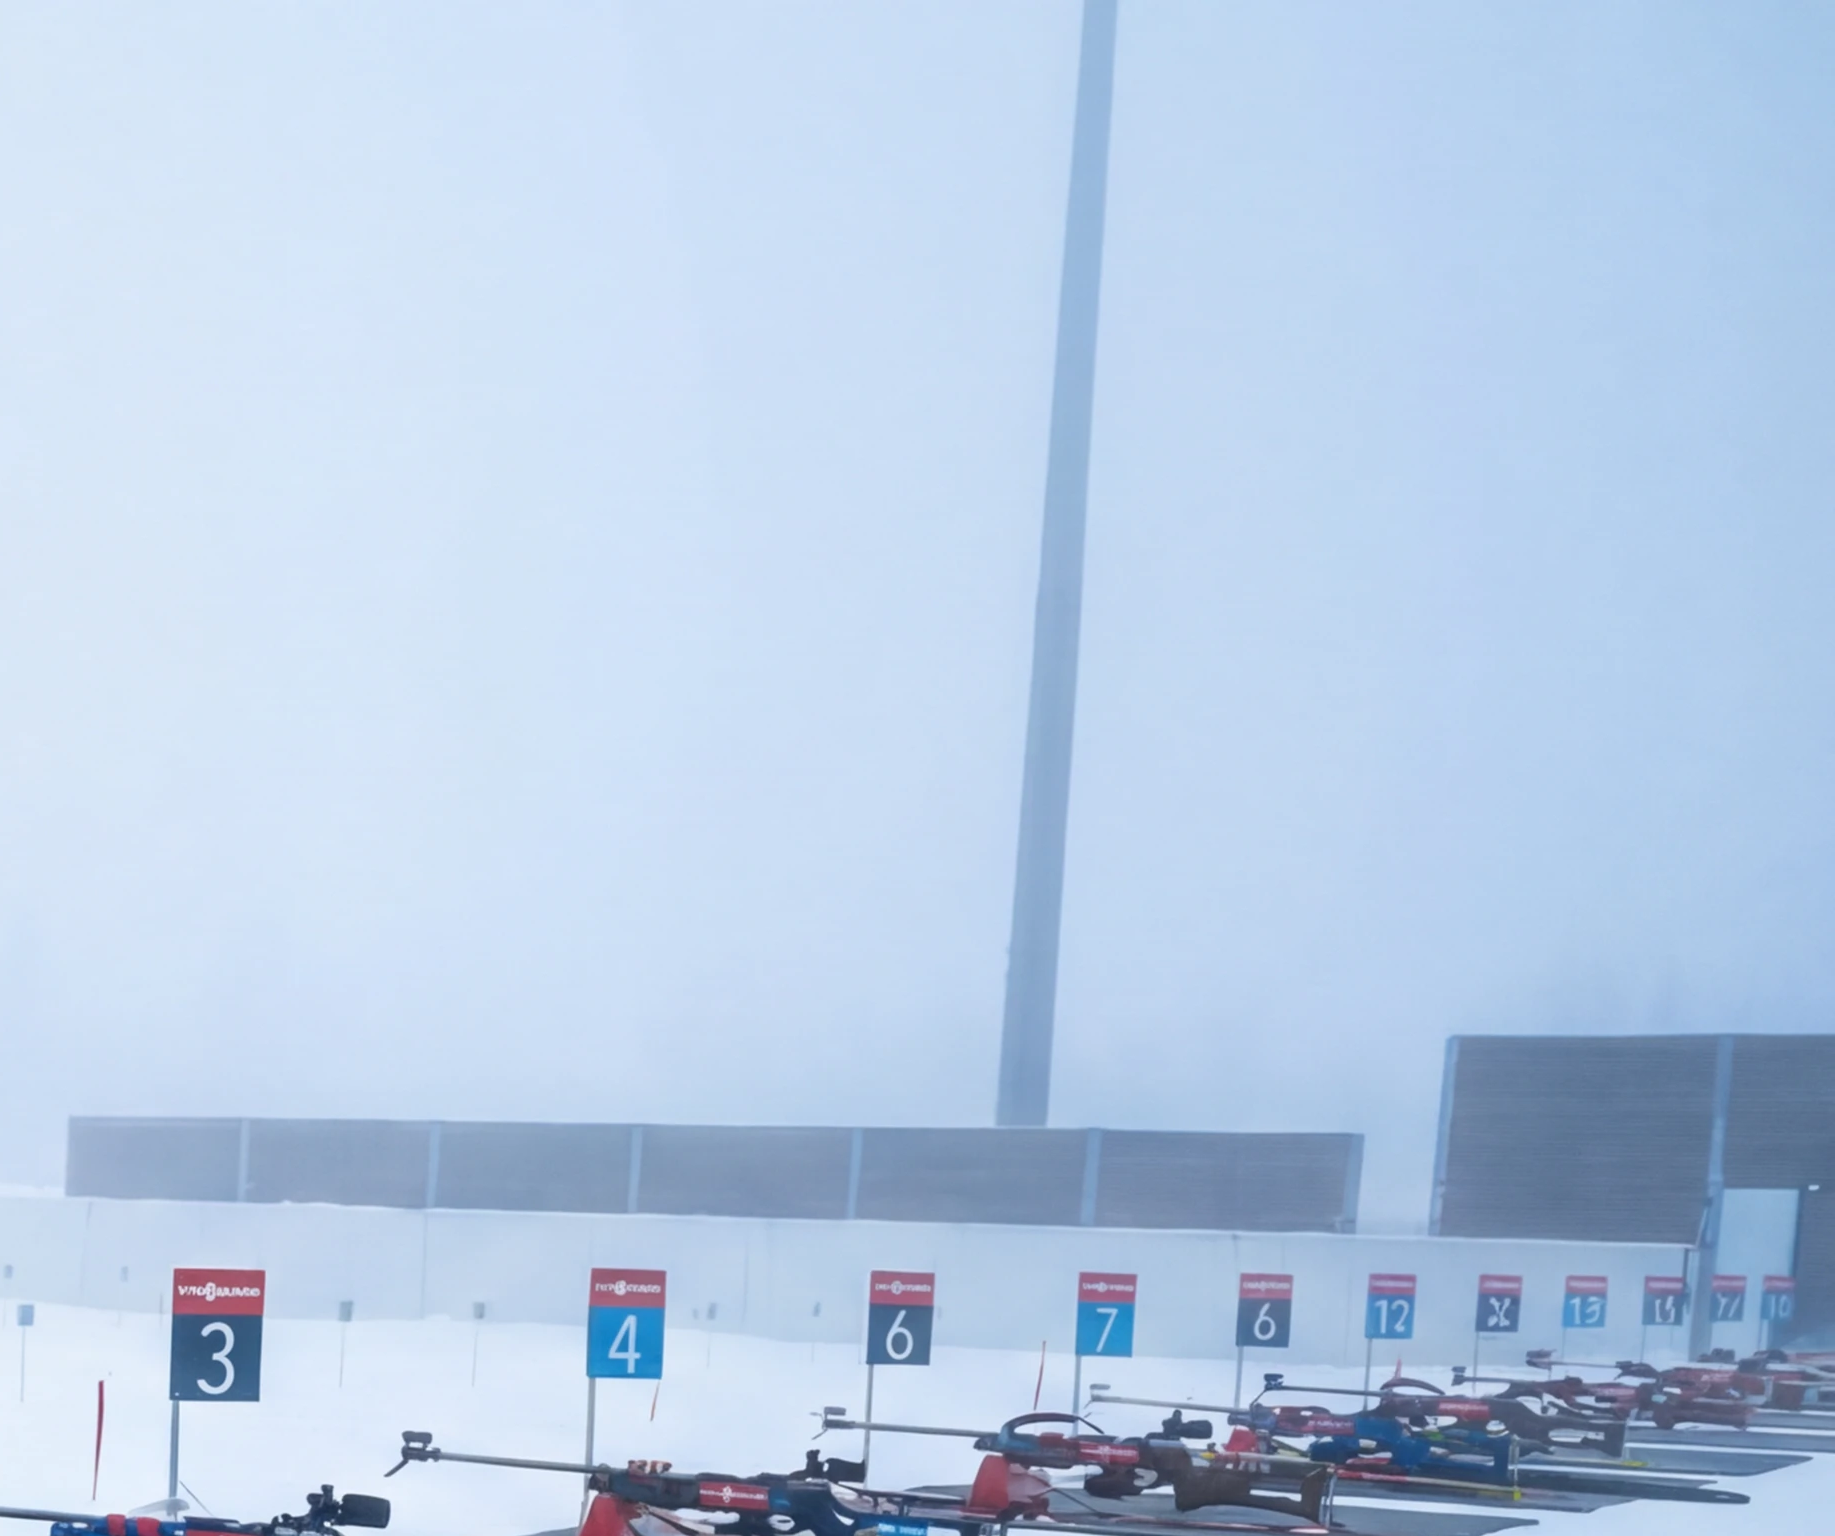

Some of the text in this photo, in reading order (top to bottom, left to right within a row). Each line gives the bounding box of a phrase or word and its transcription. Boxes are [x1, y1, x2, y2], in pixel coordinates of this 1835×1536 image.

[608, 1314, 642, 1374] 4
[886, 1309, 914, 1360] 6
[1095, 1308, 1119, 1353] 7
[1253, 1302, 1277, 1341] 6
[197, 1321, 235, 1395] 3
